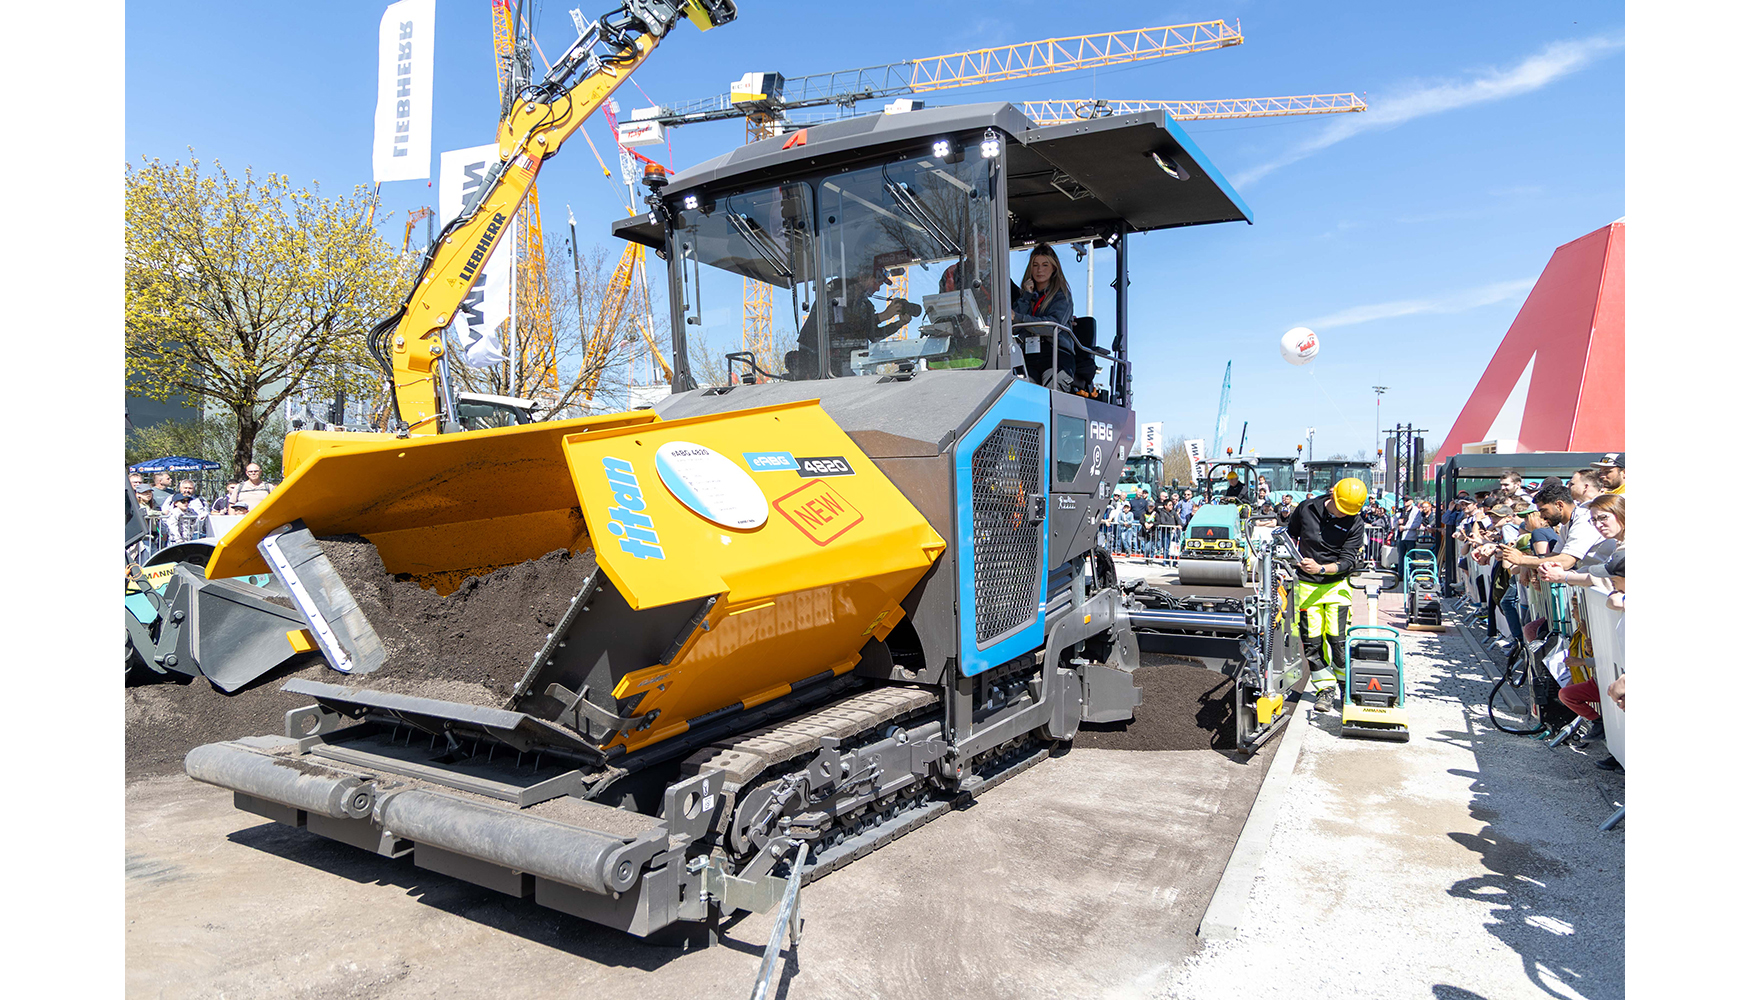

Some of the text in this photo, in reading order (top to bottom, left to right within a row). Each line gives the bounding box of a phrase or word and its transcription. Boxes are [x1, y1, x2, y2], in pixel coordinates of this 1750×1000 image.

[459, 211, 507, 282] LIEBHERR
[1090, 420, 1113, 441] ABG
[752, 455, 849, 474] eABG 4820
[602, 456, 666, 560] titan
[793, 492, 845, 530] NEW
[144, 569, 174, 579] MANN
